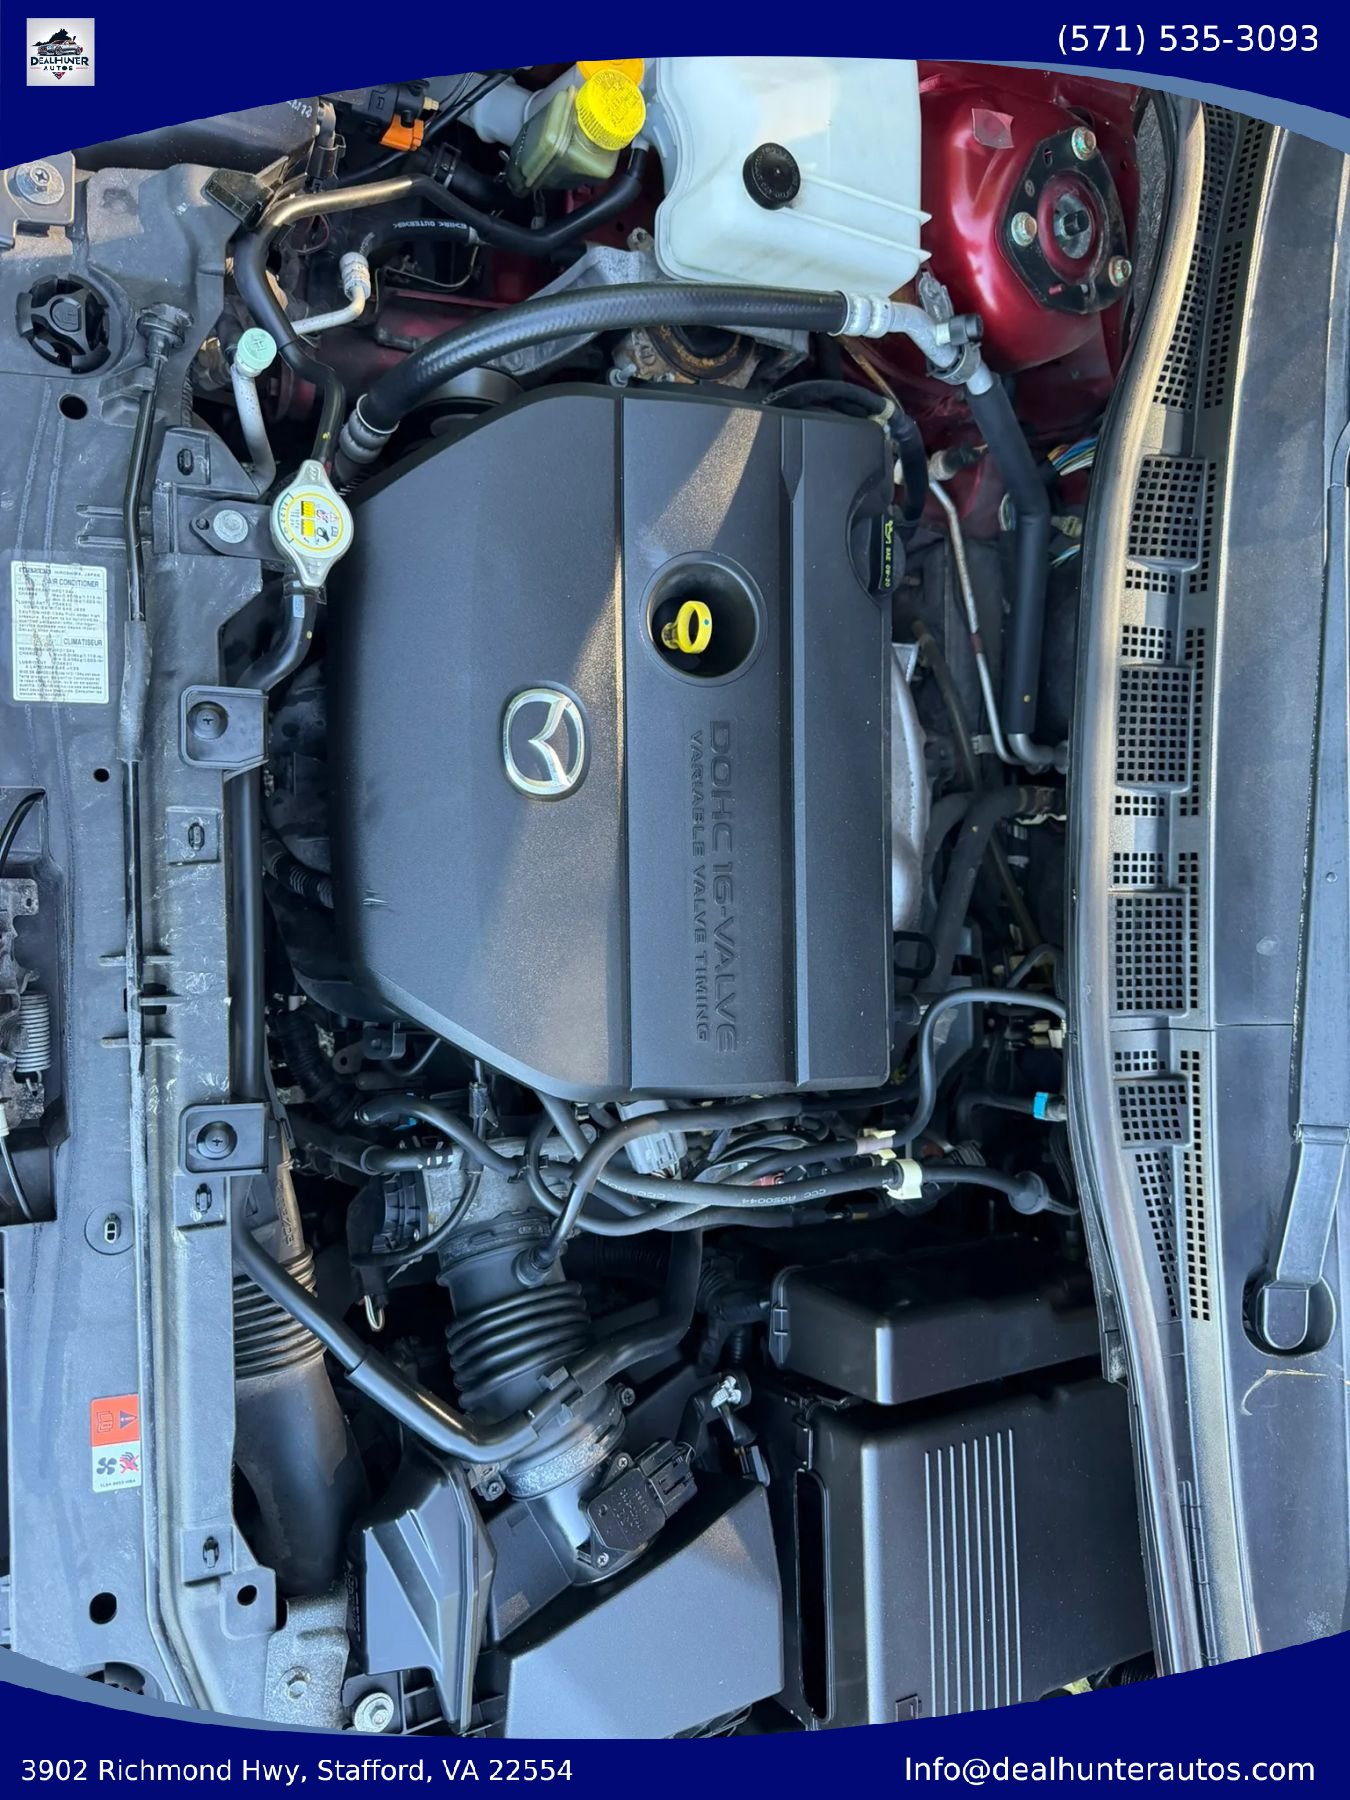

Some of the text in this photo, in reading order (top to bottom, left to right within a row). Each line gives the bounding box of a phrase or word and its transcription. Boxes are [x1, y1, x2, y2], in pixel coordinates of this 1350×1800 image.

[63, 638, 103, 647] CLIMATISEUR
[690, 730, 710, 1043] VARIABLE VALVE TIMING
[710, 720, 737, 1053] DOHC 16-VALVE
